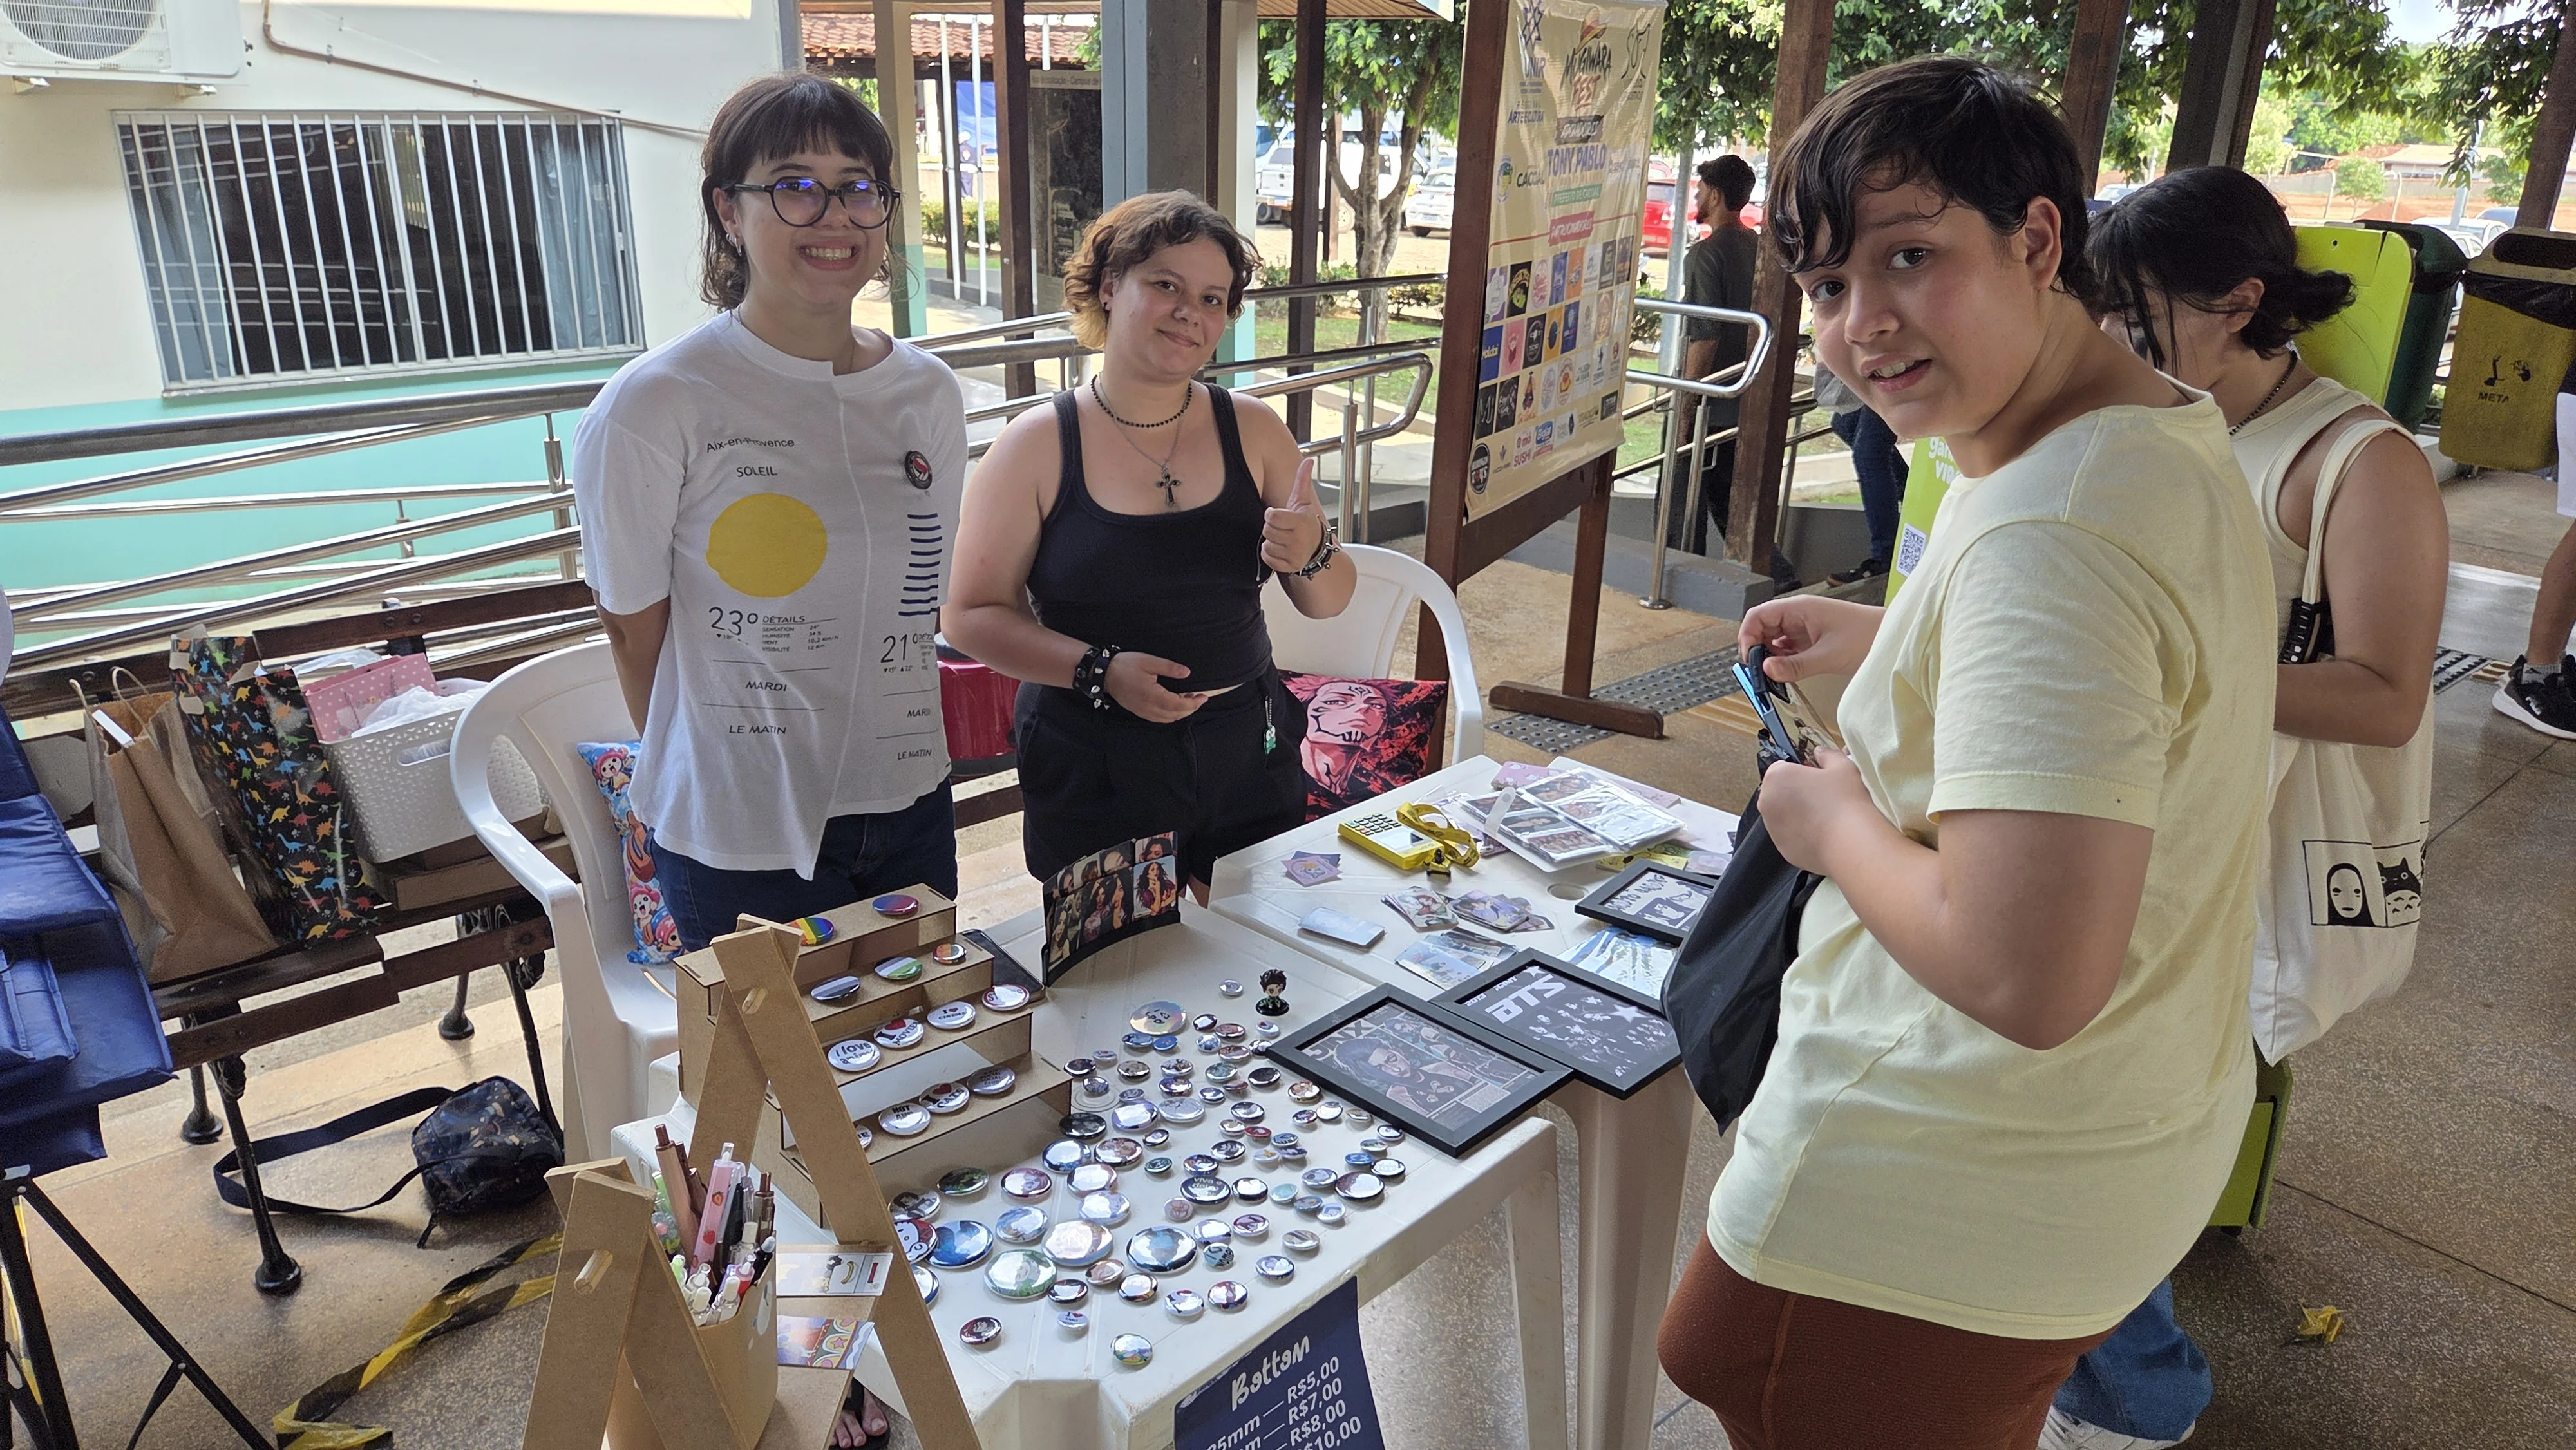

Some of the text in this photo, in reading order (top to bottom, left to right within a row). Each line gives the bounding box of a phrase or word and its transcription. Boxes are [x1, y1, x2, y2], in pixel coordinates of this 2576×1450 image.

[1547, 146, 1575, 177] TONY
[1575, 144, 1607, 173] PABLO
[706, 437, 795, 453] Aix-en-Provence
[736, 466, 778, 478] SOLEIL
[745, 681, 787, 692] MARDI
[729, 725, 787, 735] LE MATIN
[897, 749, 932, 760] LE MATIN
[1484, 974, 1566, 1024] BTS
[938, 1012, 967, 1020] CINEMA
[875, 1031, 896, 1041] I
[840, 1042, 872, 1055] love
[936, 1088, 965, 1108] CATS
[1287, 1355, 1340, 1404] R$5,00
[1288, 1377, 1343, 1426] R$7,00
[1290, 1399, 1347, 1447] R$8,00
[1298, 1416, 1361, 1450] $10,00
